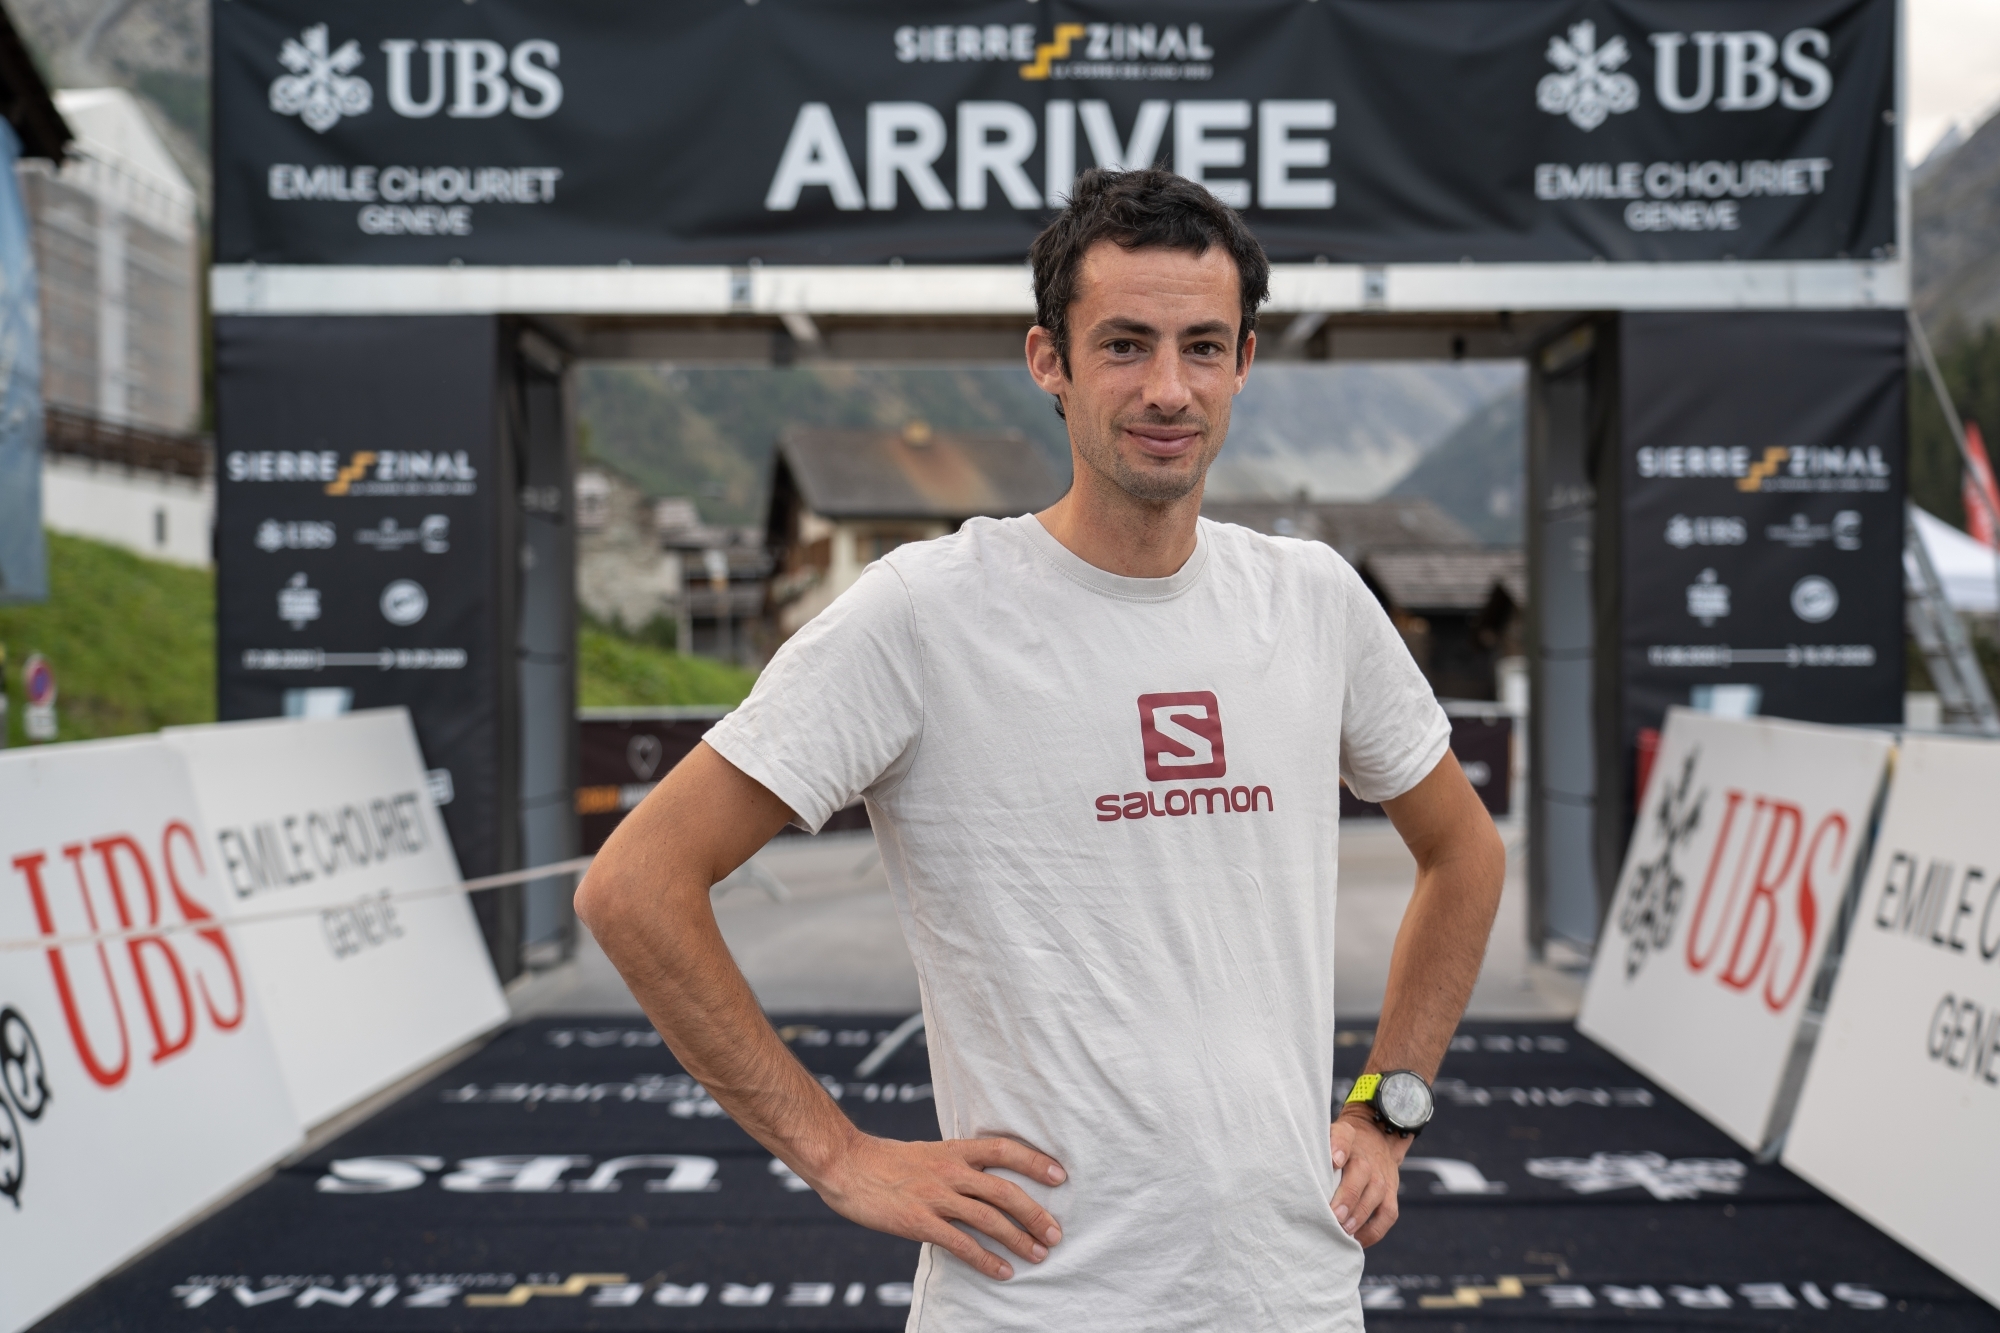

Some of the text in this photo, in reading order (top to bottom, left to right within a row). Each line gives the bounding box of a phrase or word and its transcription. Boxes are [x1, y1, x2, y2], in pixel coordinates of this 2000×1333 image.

[896, 23, 1214, 62] SIERRE ZINAL
[380, 38, 564, 119] UBS
[1648, 28, 1833, 113] UBS
[765, 100, 1336, 210] ARRIVEE
[269, 164, 562, 203] EMILE CHOURIET
[1535, 158, 1832, 200] EMILE CHOURIET
[358, 206, 472, 234] GENEVE
[1624, 202, 1740, 231] GENEVE
[227, 450, 477, 481] SIERRE ZINAL
[1637, 445, 1890, 477] SIERRE ZINAL
[1095, 786, 1274, 822] salomon
[218, 790, 432, 900] EMILE CHOURIET
[1685, 788, 1850, 1016] UBS
[1875, 850, 1984, 954] EMILE
[12, 819, 246, 1090] UBS
[315, 1154, 722, 1193] UBS
[171, 1284, 465, 1308] ZINAL
[1538, 1282, 1888, 1309] SIERRE
